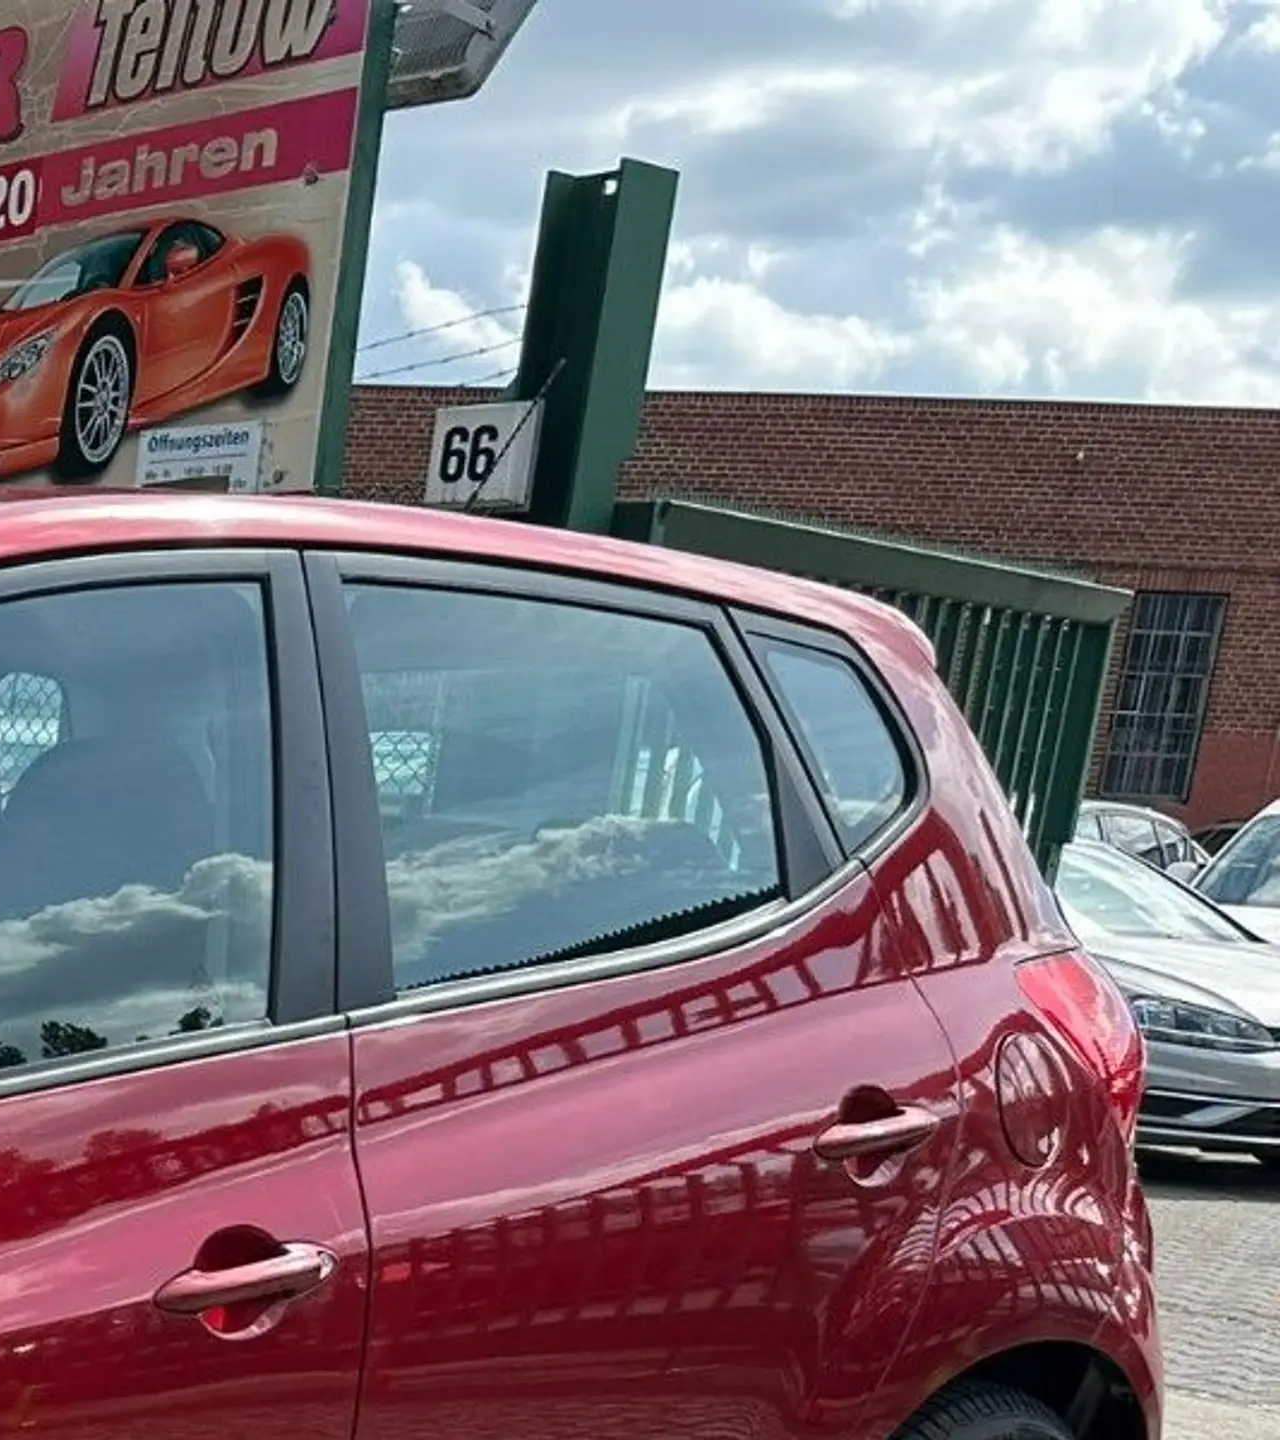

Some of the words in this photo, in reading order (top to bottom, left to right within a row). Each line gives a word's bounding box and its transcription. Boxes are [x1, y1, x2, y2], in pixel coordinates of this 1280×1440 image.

[60, 126, 279, 208] Jahren
[146, 427, 250, 454] Öffnungszeiten
[440, 424, 499, 484] 66
